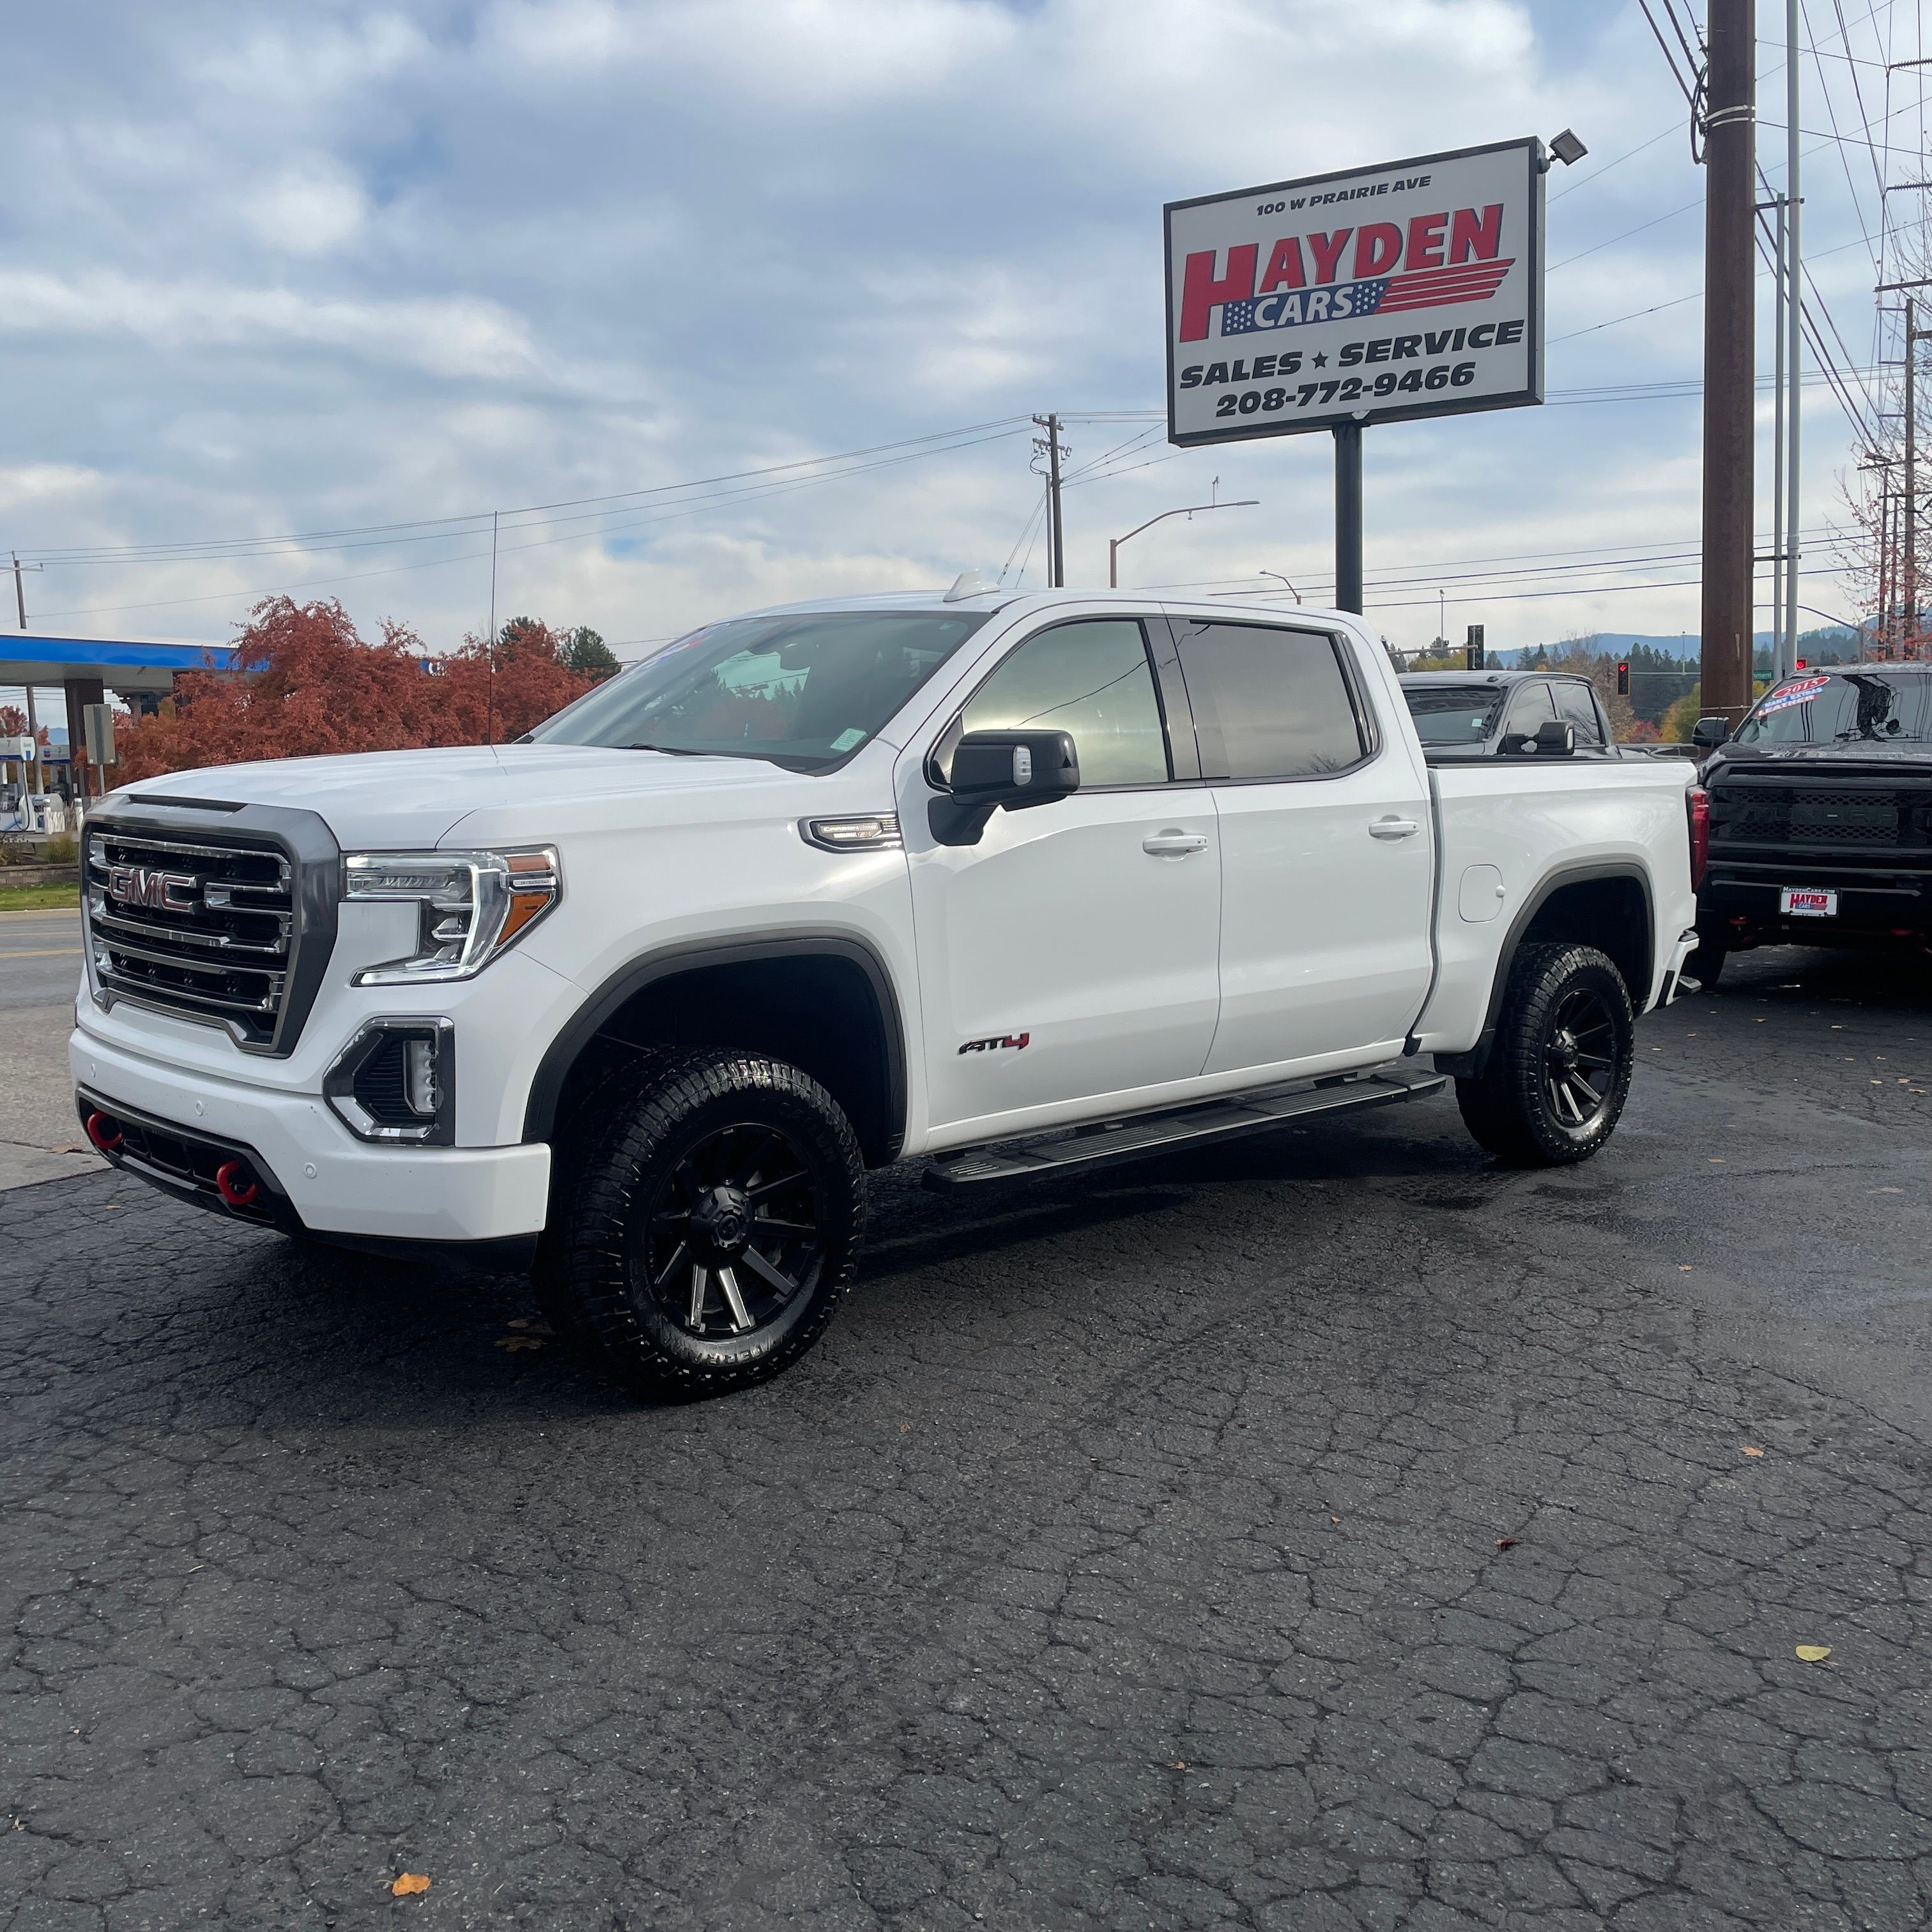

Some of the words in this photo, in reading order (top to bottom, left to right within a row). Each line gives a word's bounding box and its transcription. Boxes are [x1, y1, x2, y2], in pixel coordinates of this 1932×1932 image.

[1256, 201, 1285, 216] 100
[1289, 197, 1307, 210] W
[1309, 182, 1390, 208] PRAIRIE
[1392, 174, 1432, 193] AVE
[1179, 203, 1504, 342] HAYDEN
[1254, 286, 1354, 328] CARS
[1179, 351, 1303, 389] SALES
[1338, 319, 1524, 367] SERVICE
[1215, 362, 1476, 417] 208-772-9466
[1765, 698, 1788, 707] MANY
[1791, 687, 1823, 699] EXTRAS
[1784, 680, 1818, 694] 2015
[109, 866, 196, 914] GMC
[1790, 894, 1827, 909] HAYDEN
[957, 1032, 1029, 1055] AT4
